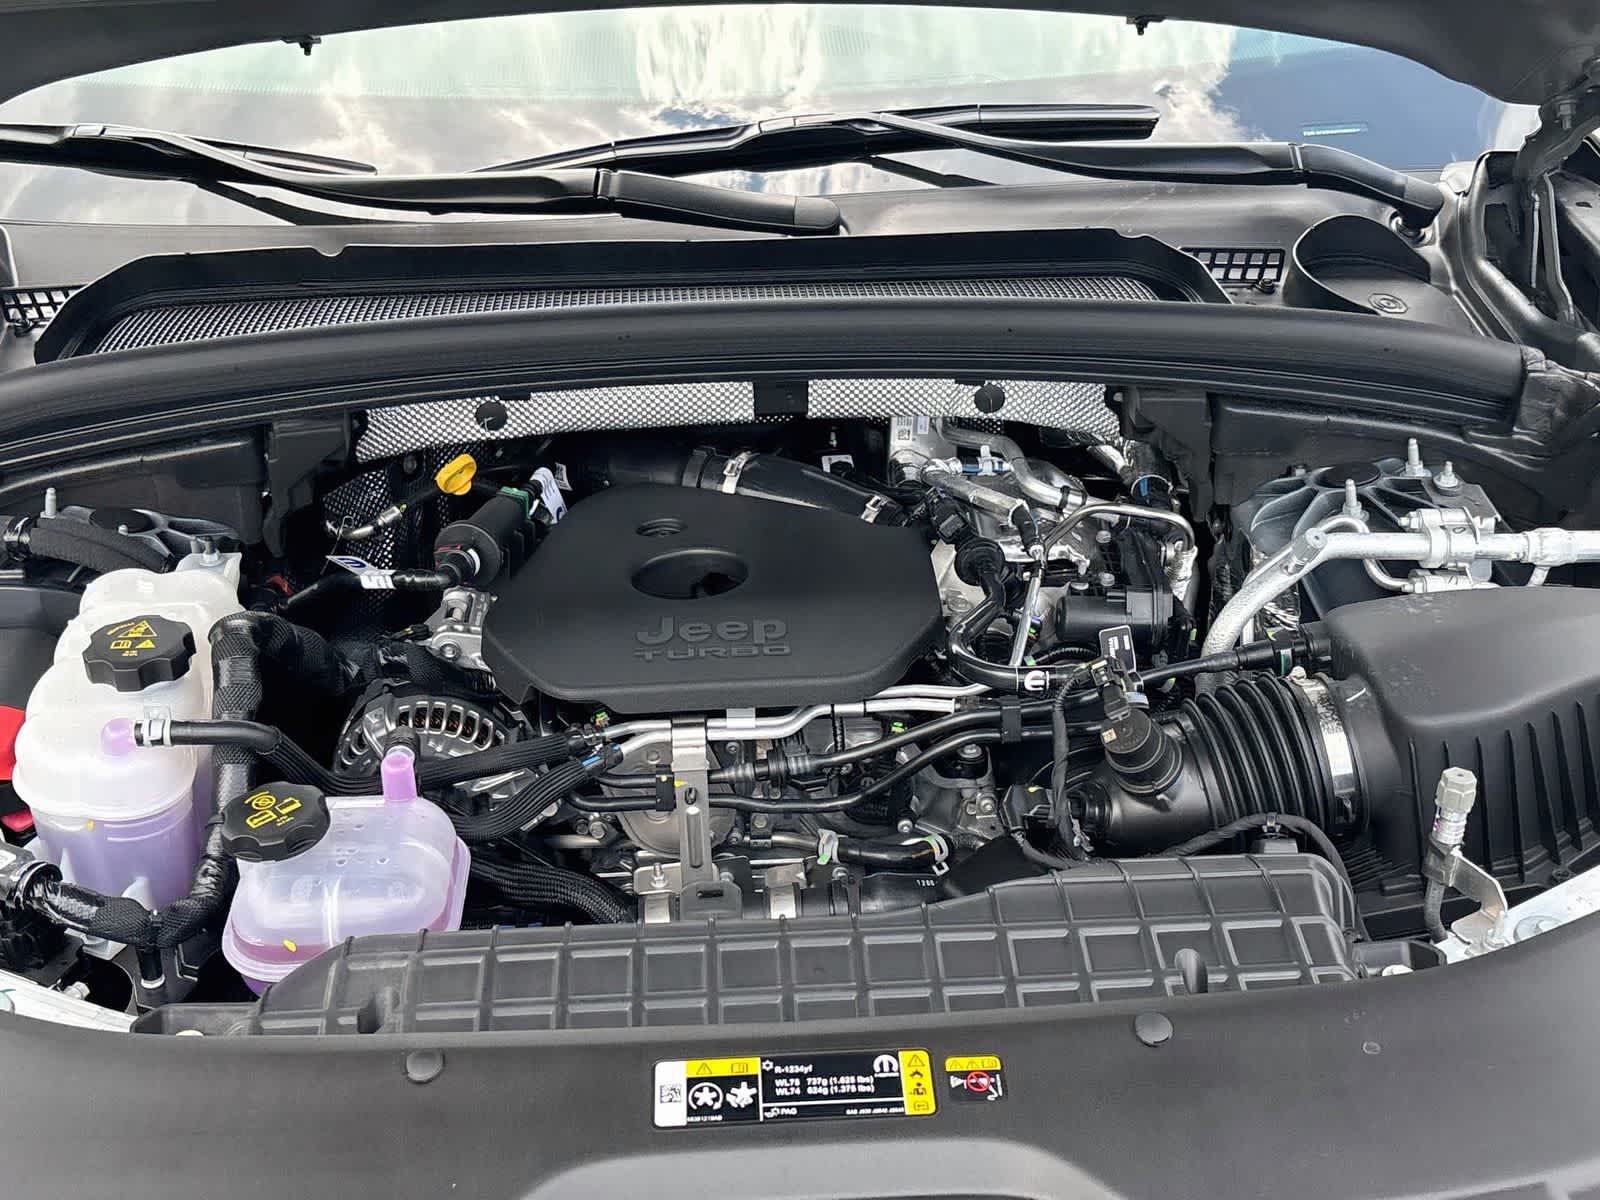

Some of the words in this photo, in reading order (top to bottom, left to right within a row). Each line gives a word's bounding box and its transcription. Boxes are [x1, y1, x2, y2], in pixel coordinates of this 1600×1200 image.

[635, 616, 787, 645] Jeep
[633, 645, 792, 662] TURBO
[774, 1064, 813, 1074] R-1234yf
[806, 1077, 828, 1086] 737g
[856, 1075, 874, 1084] lbs)
[775, 1087, 801, 1096] WL74
[806, 1086, 829, 1095] 624g
[858, 1084, 875, 1093] lbs)
[780, 1107, 798, 1115] PAG
